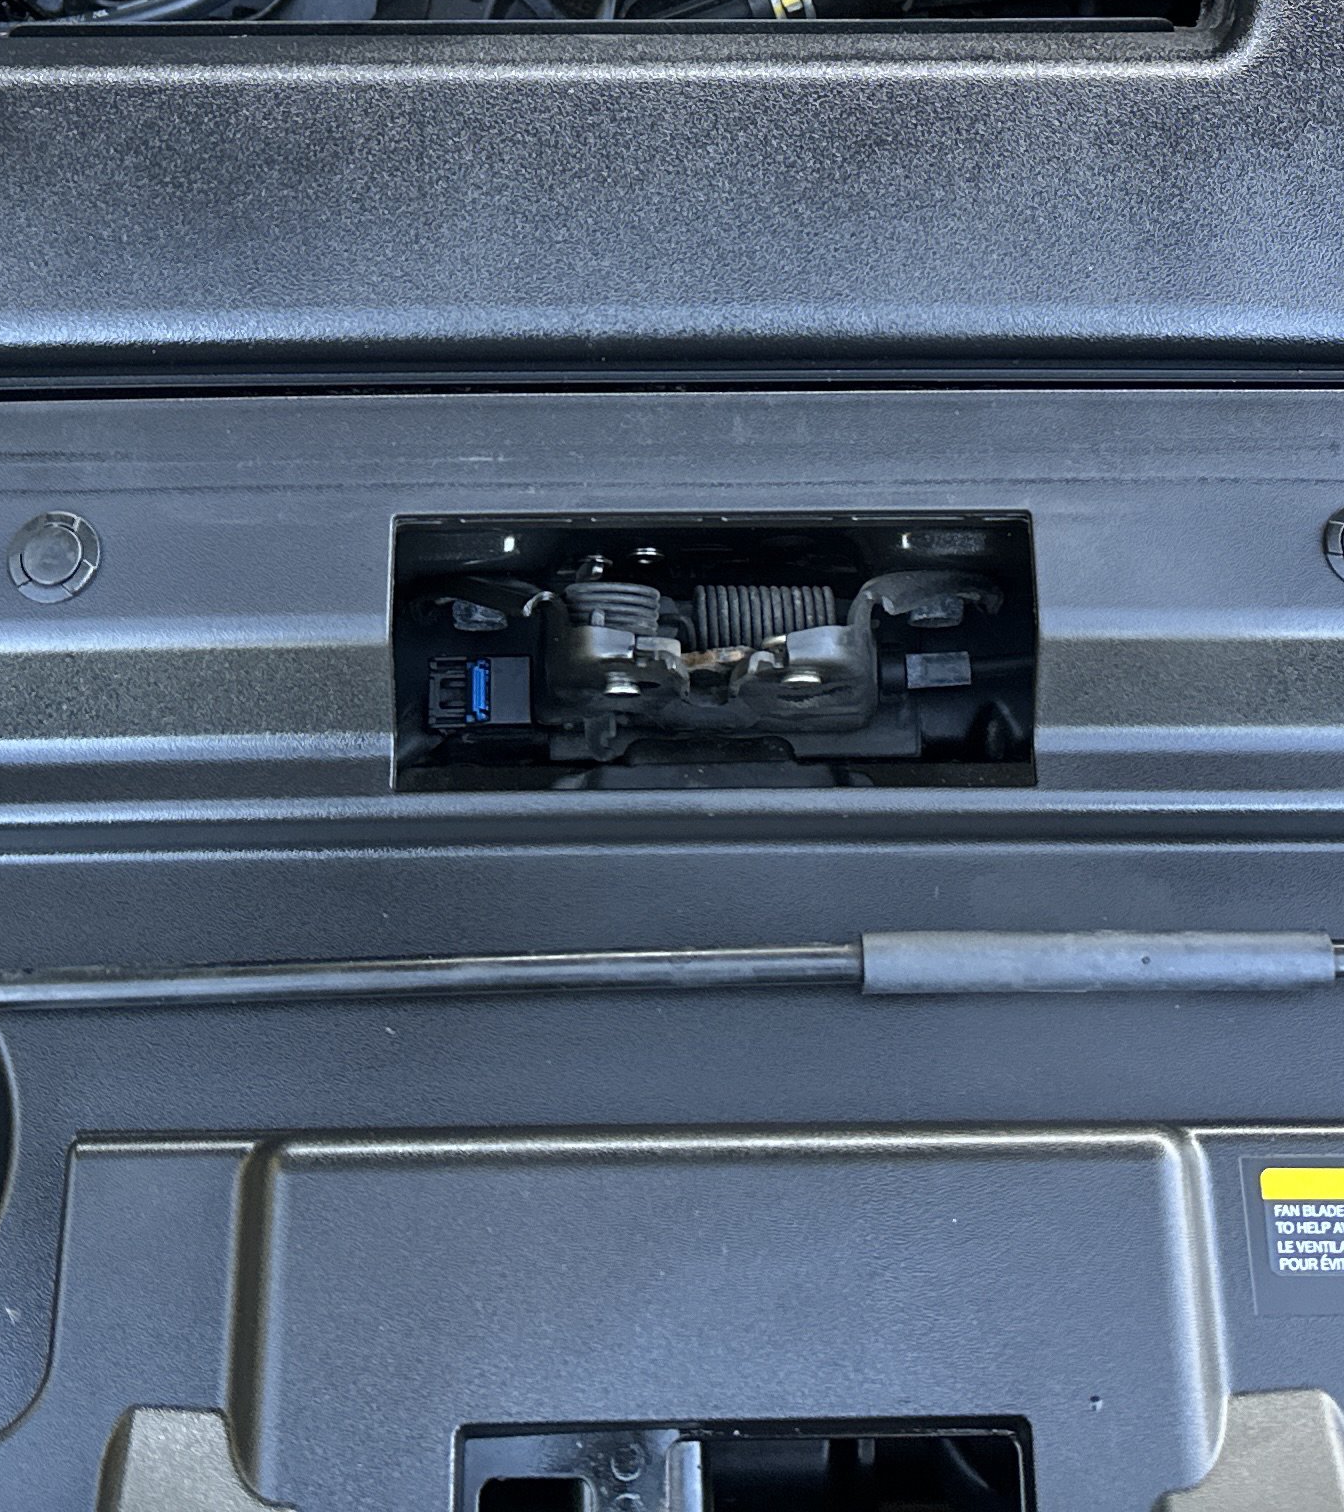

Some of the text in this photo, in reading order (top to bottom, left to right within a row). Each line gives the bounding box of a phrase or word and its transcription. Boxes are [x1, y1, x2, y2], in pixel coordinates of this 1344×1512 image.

[1273, 1204, 1301, 1218] FAN
[1302, 1204, 1344, 1218] BLADE
[1275, 1221, 1295, 1235] TO
[1296, 1221, 1331, 1235] HELP
[1277, 1240, 1295, 1254] LE
[1279, 1258, 1318, 1271] POUR
